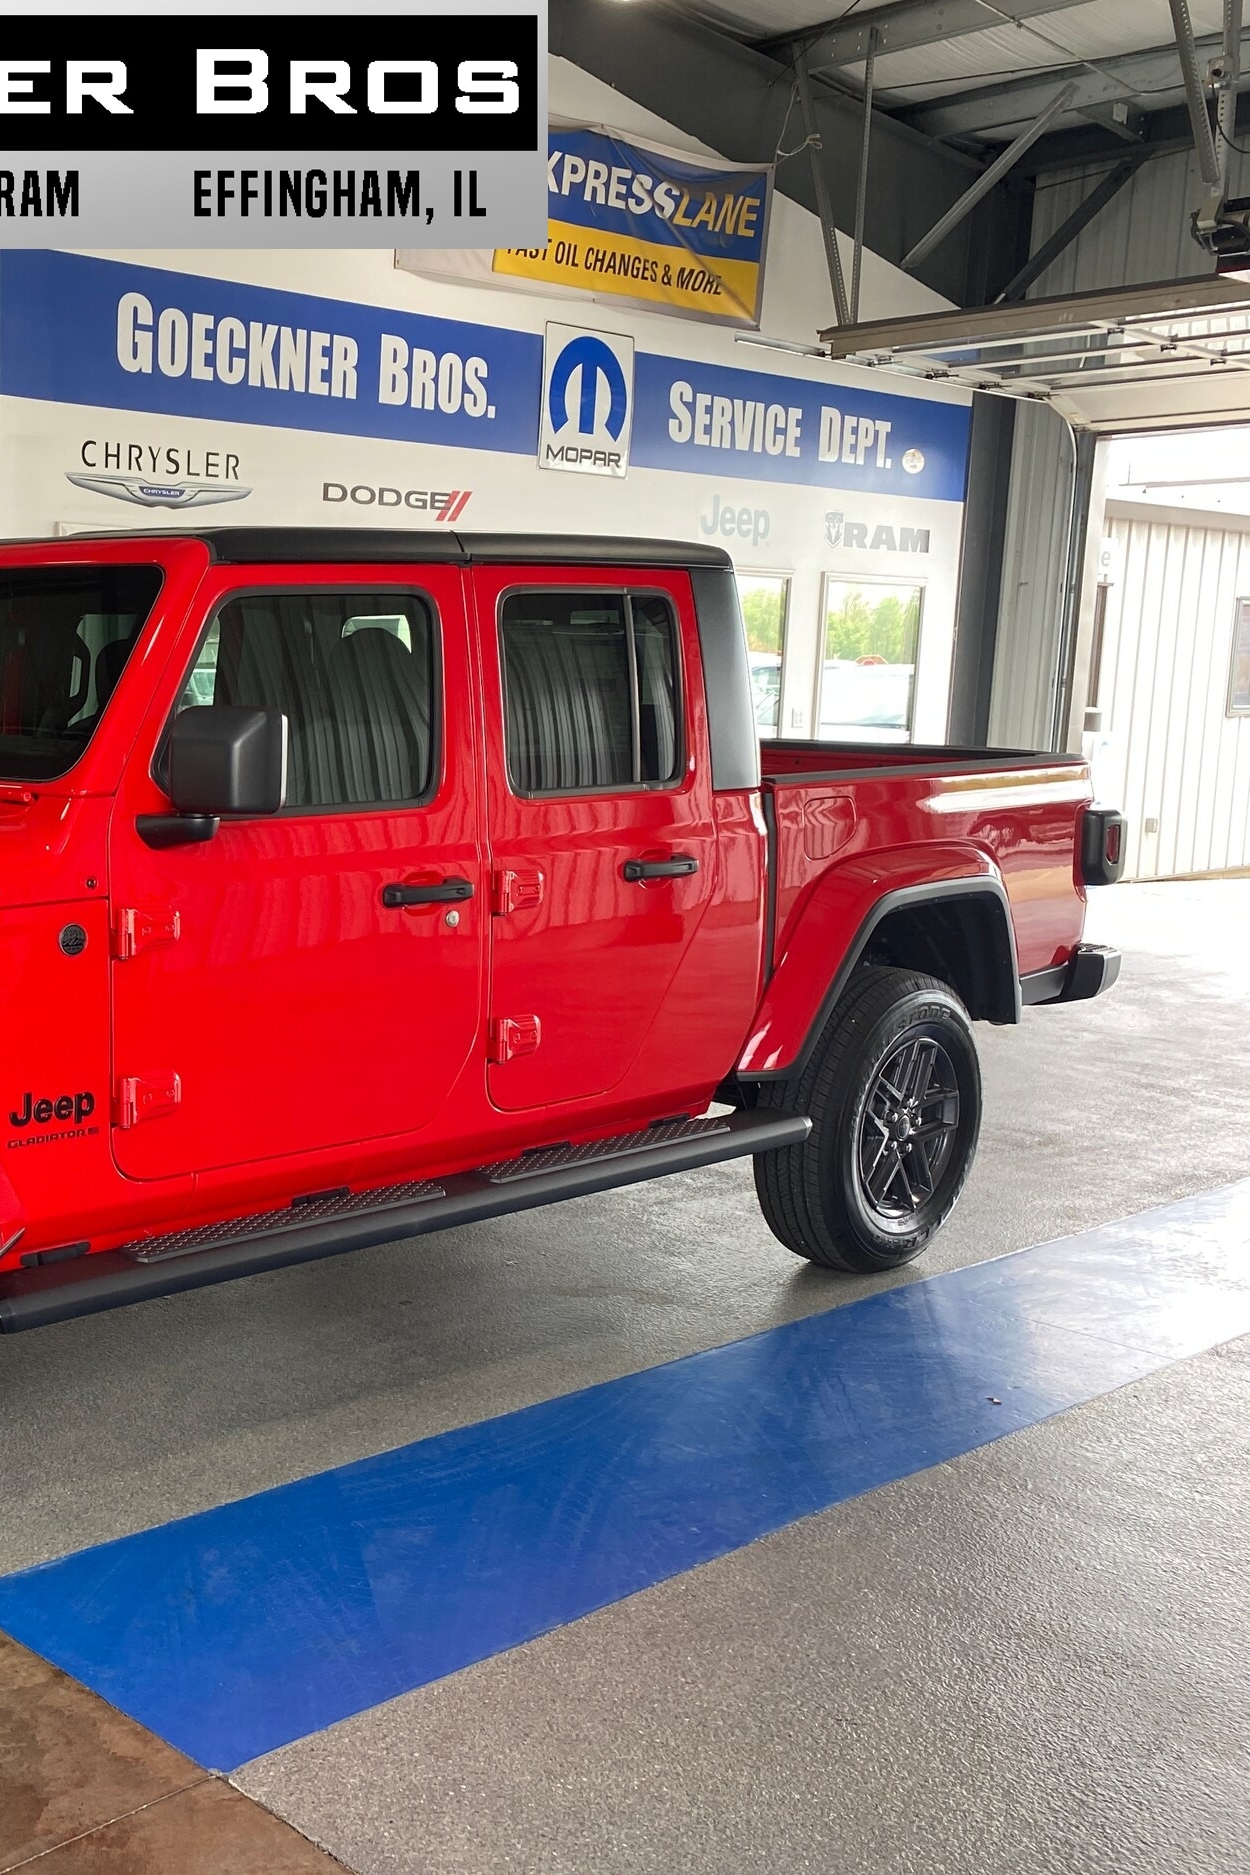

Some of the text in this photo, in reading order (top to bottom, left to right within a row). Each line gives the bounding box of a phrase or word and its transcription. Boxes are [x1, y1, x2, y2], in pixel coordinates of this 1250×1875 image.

[554, 241, 580, 268] OIL
[584, 246, 659, 282] CHANGES
[661, 263, 673, 287] &
[676, 266, 723, 296] MORE
[117, 291, 497, 419] GOECKNER BROS.
[668, 380, 892, 469] SERVICE DEPT.
[81, 440, 240, 480] CHRYSLER
[546, 443, 621, 468] MOPAR
[142, 487, 180, 497] CHRYSLER
[322, 482, 451, 511] DODGE
[700, 494, 771, 547] Jeep
[842, 521, 931, 554] RAM
[9, 1091, 95, 1128] Jeep
[7, 1128, 86, 1149] GLADIATOR
